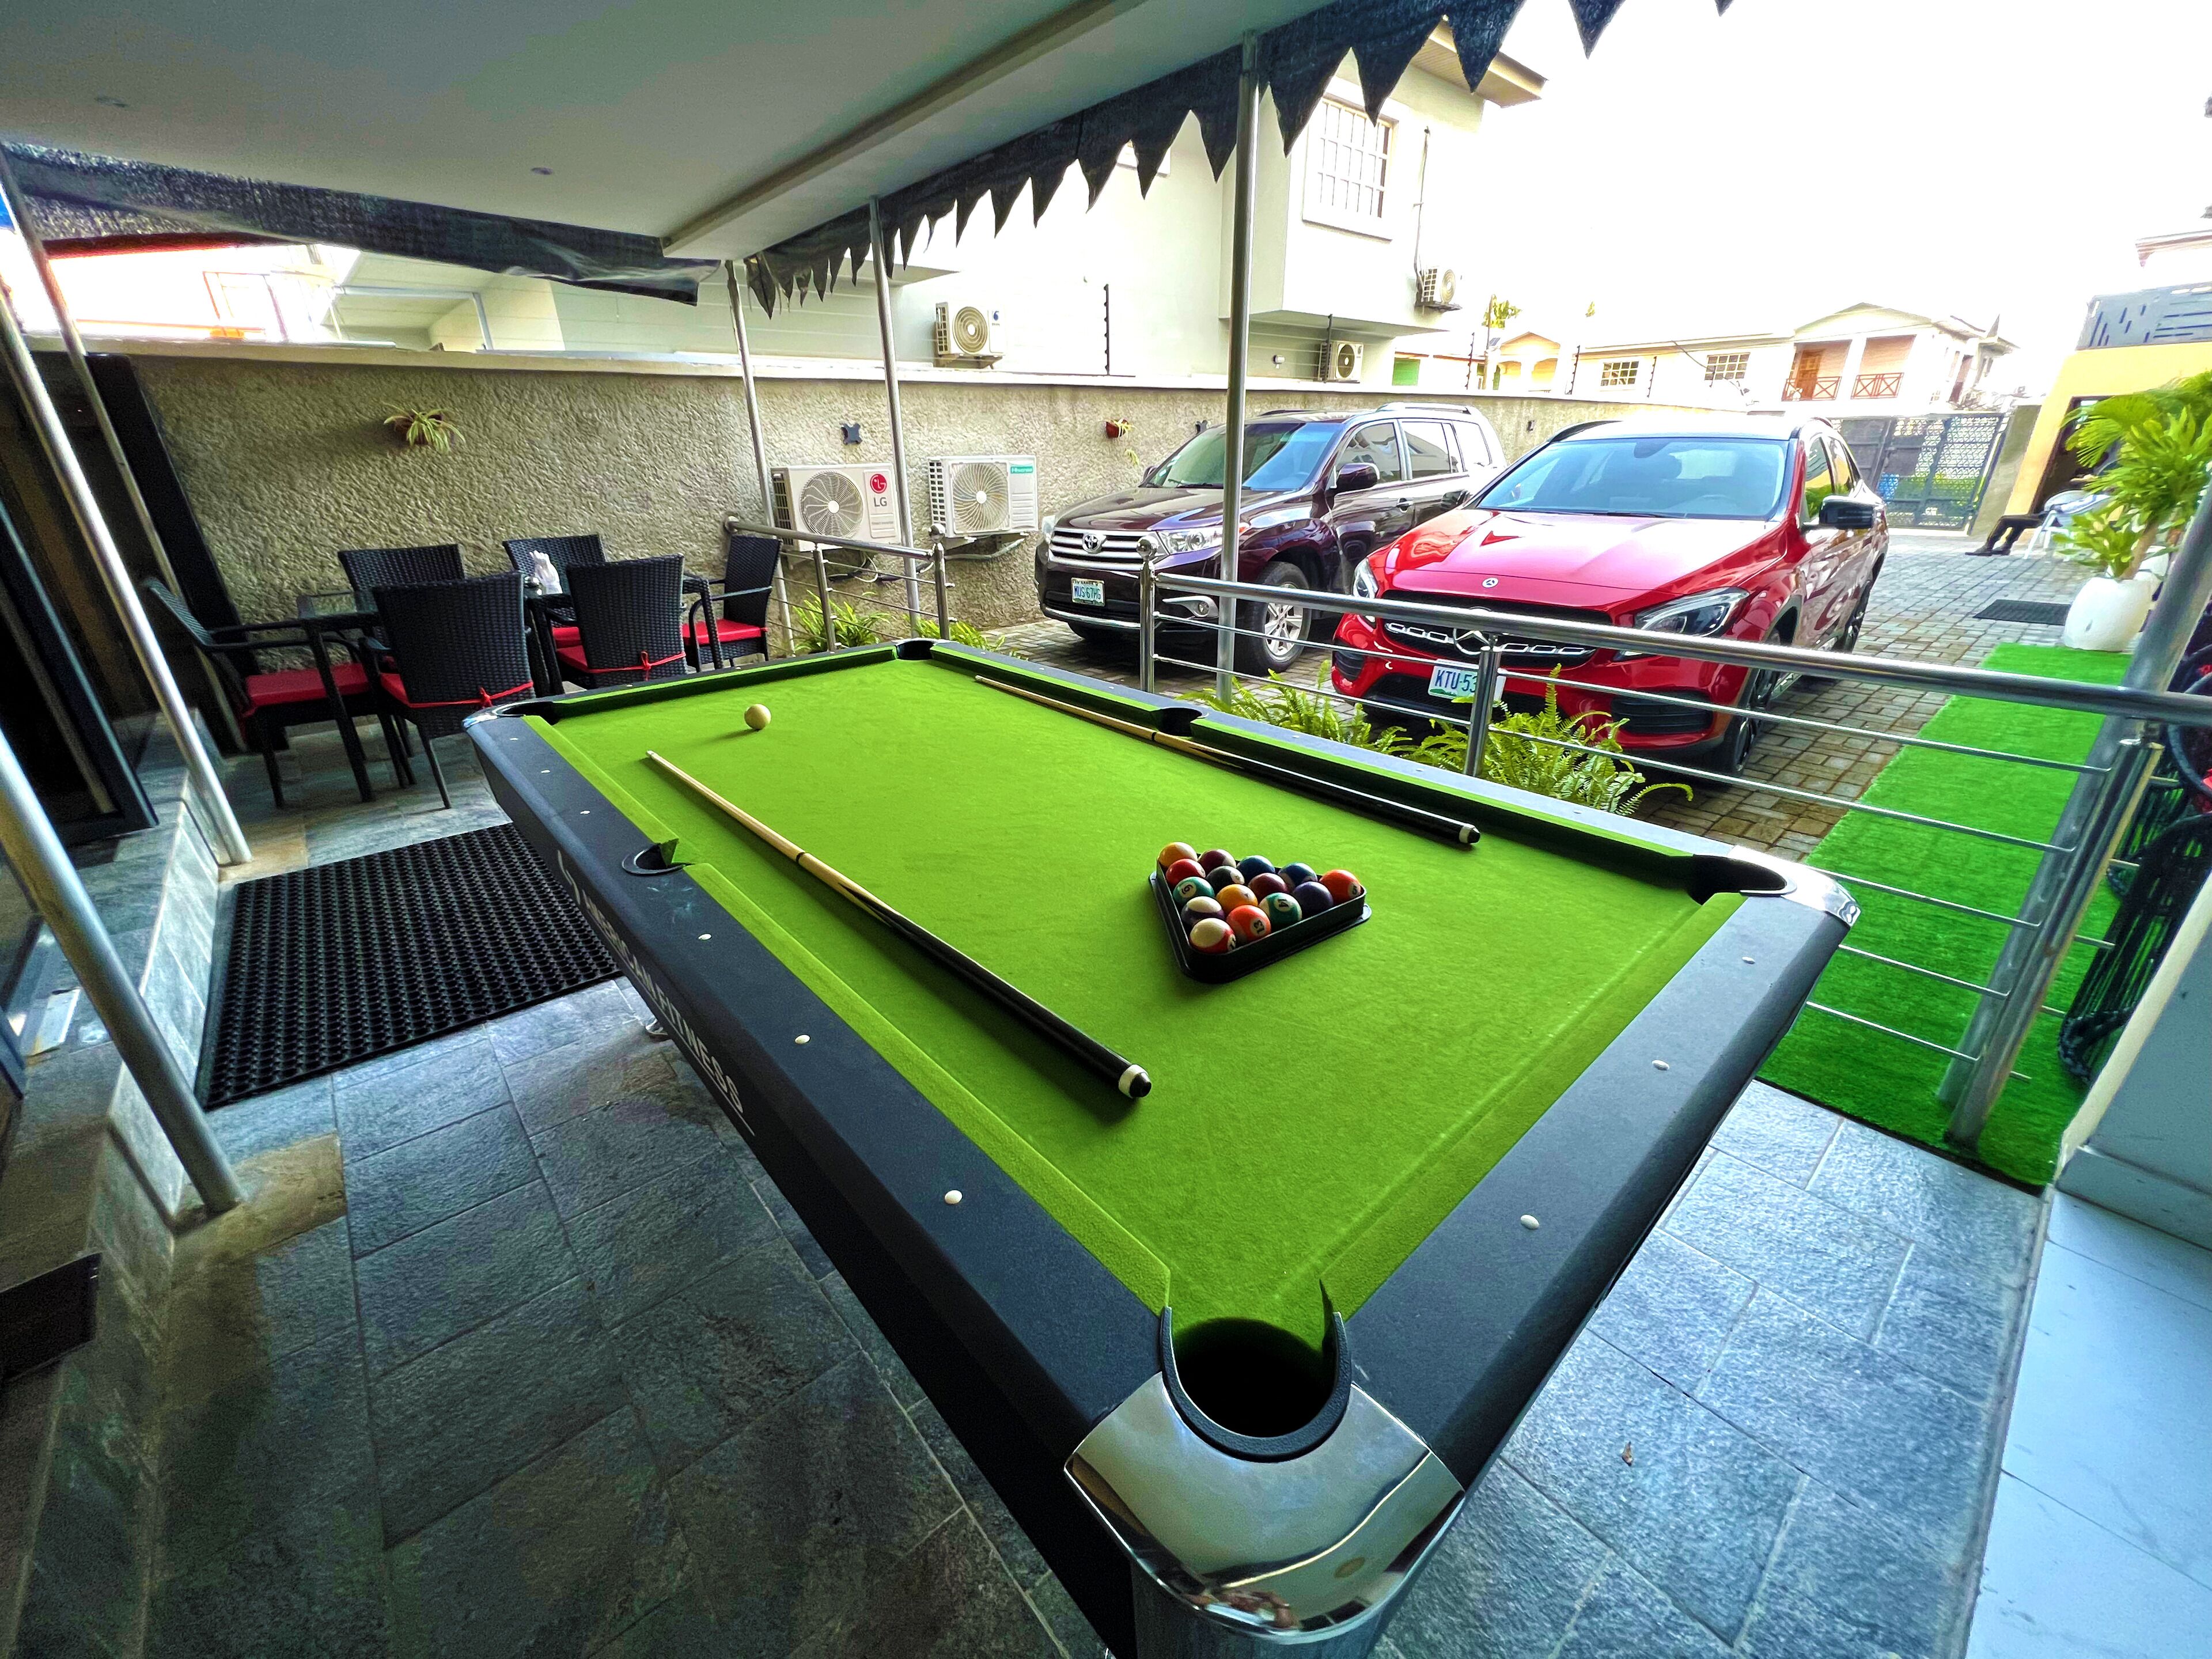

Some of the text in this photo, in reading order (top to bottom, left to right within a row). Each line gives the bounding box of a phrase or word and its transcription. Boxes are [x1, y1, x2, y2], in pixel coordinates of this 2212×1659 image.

[873, 497, 888, 507] LG
[1253, 919, 1265, 934] 13
[653, 983, 743, 1113] FITNESS
